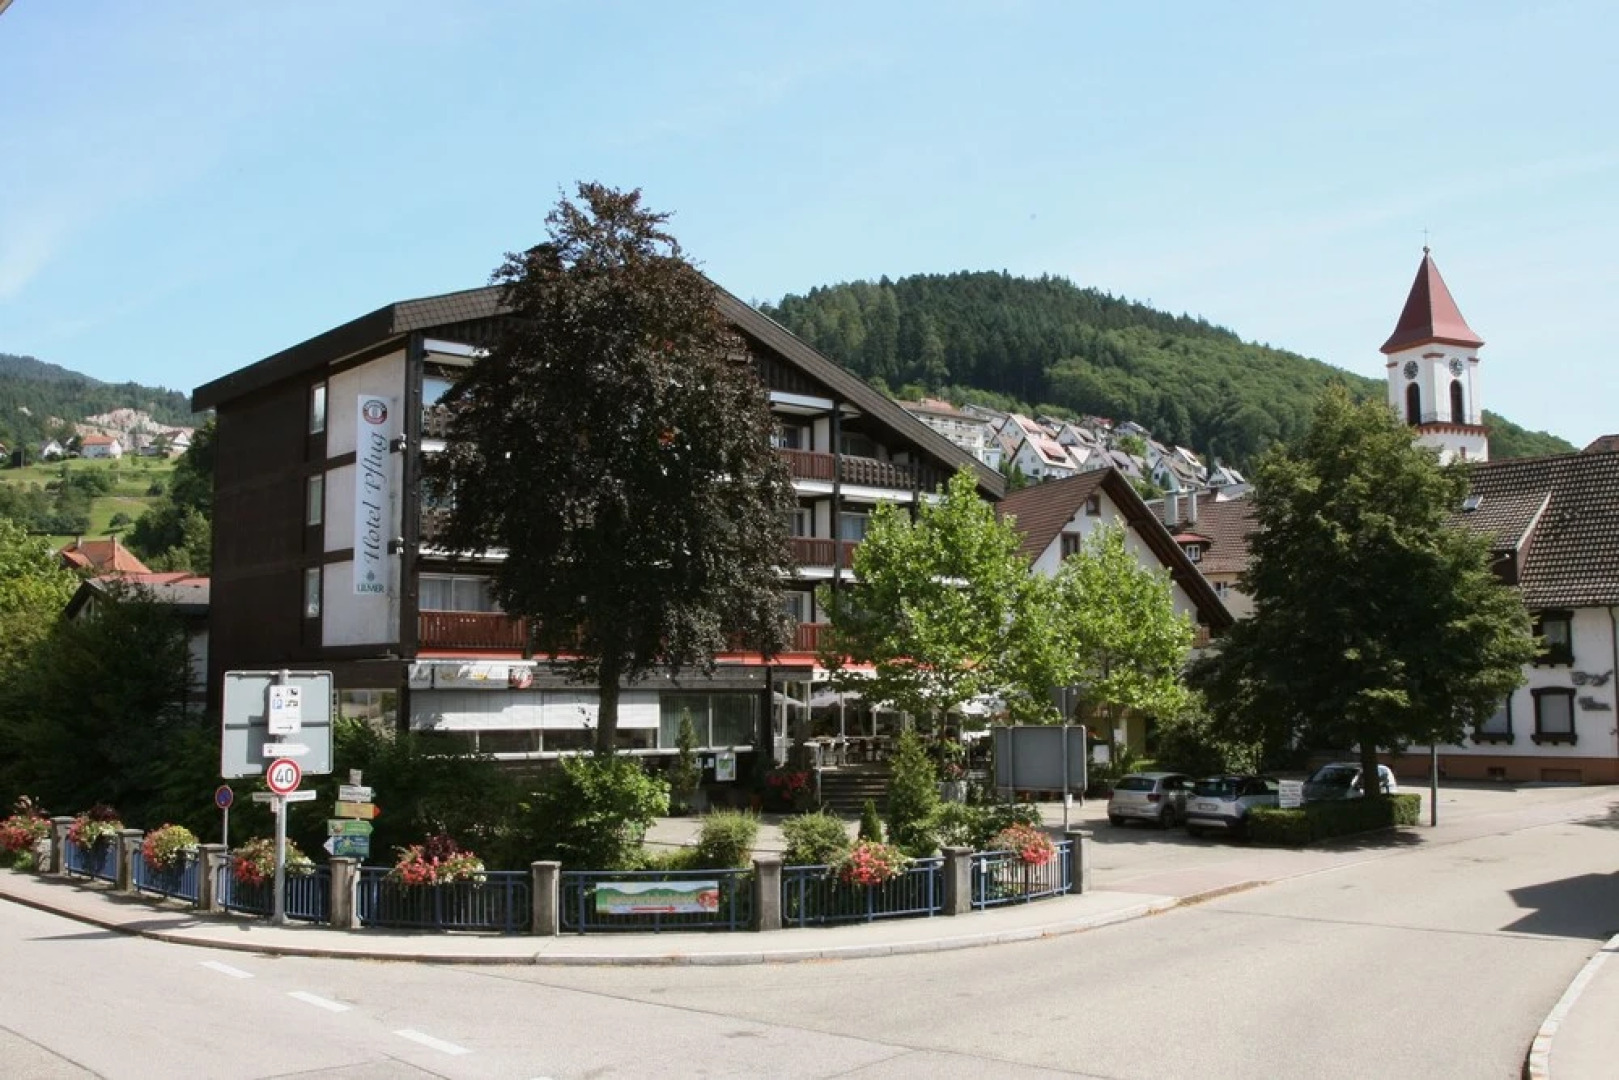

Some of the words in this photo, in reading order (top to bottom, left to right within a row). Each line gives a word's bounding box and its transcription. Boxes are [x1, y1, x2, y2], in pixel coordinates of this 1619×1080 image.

[362, 432, 387, 495] Pflug
[362, 501, 382, 564] Hotel
[275, 768, 294, 783] 40
